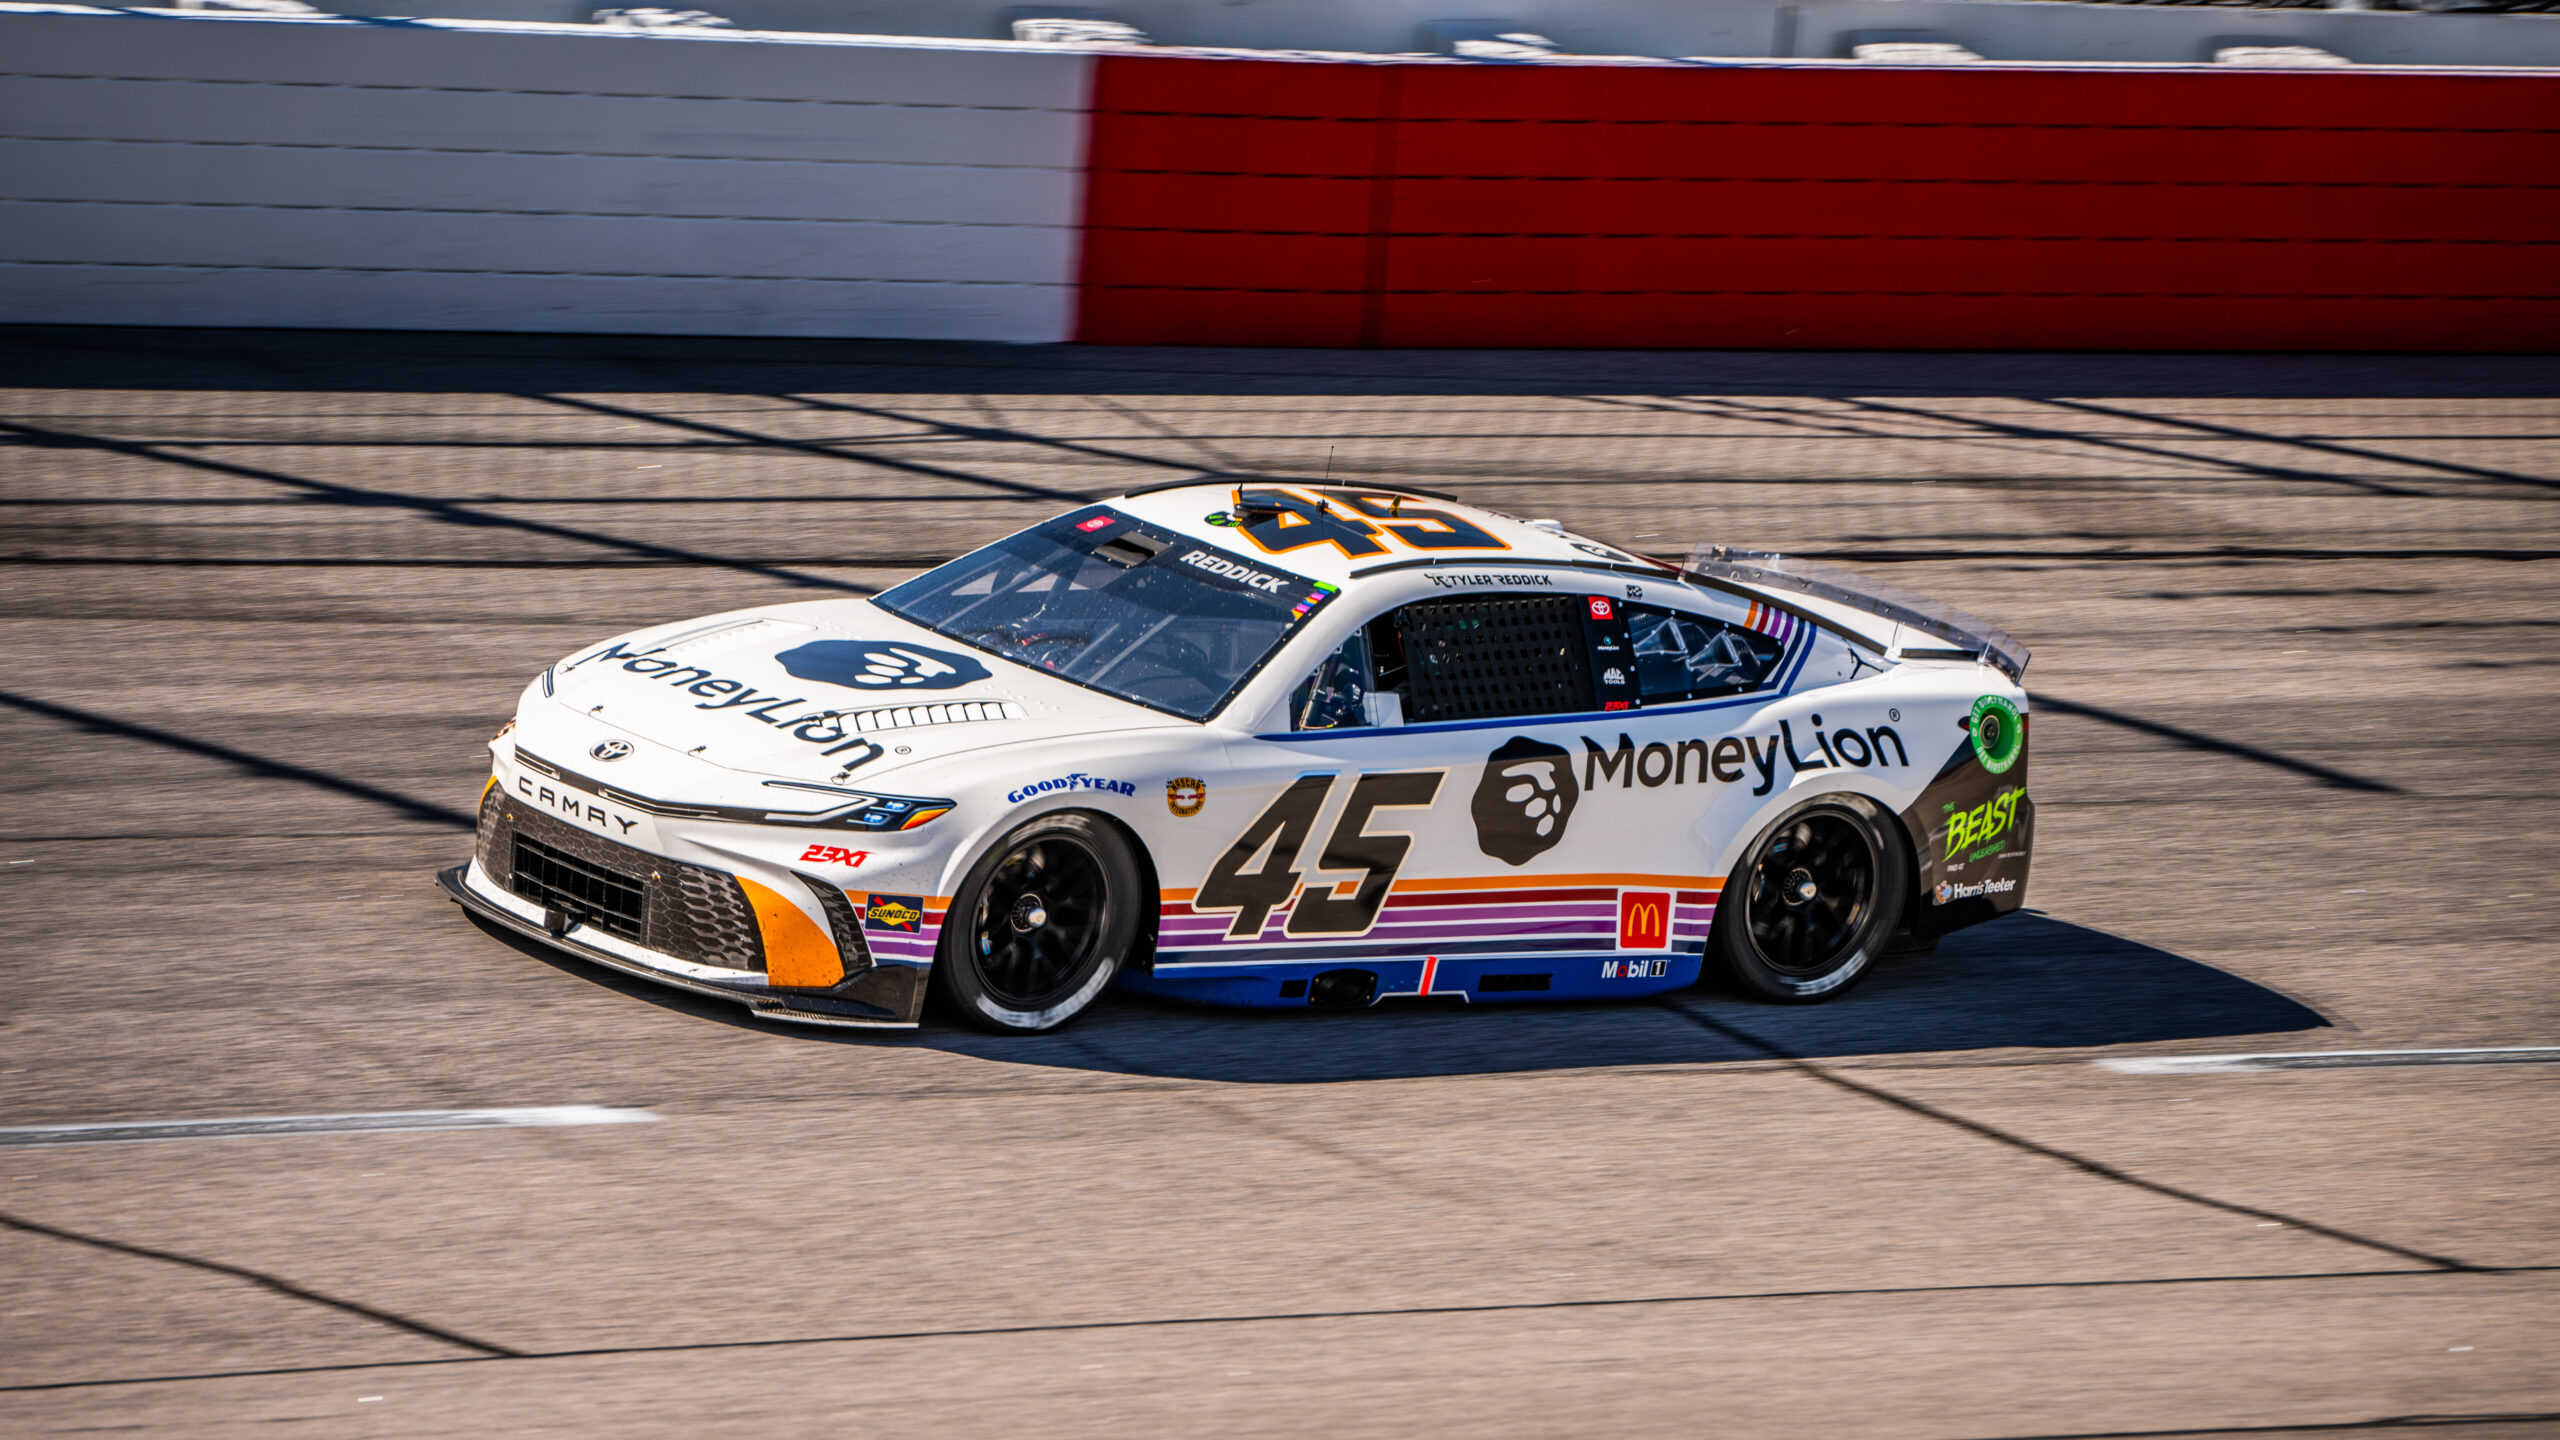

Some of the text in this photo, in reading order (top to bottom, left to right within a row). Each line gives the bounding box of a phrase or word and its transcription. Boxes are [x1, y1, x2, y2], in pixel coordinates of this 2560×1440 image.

[1231, 486, 1513, 561] 45
[1179, 549, 1290, 594] REDDICK
[1447, 574, 1553, 586] TYLER REDDICK
[574, 641, 885, 772] MoneyLion
[1579, 713, 1910, 797] MoneyLion
[518, 775, 639, 835] CAMRY
[1170, 777, 1201, 793] NASCAR
[1942, 785, 2026, 863] BEAST
[1190, 766, 1452, 942] 45
[1953, 877, 2016, 899] Harris Teeter
[869, 908, 919, 921] SUNOCO
[1601, 960, 1650, 979] Mobil
